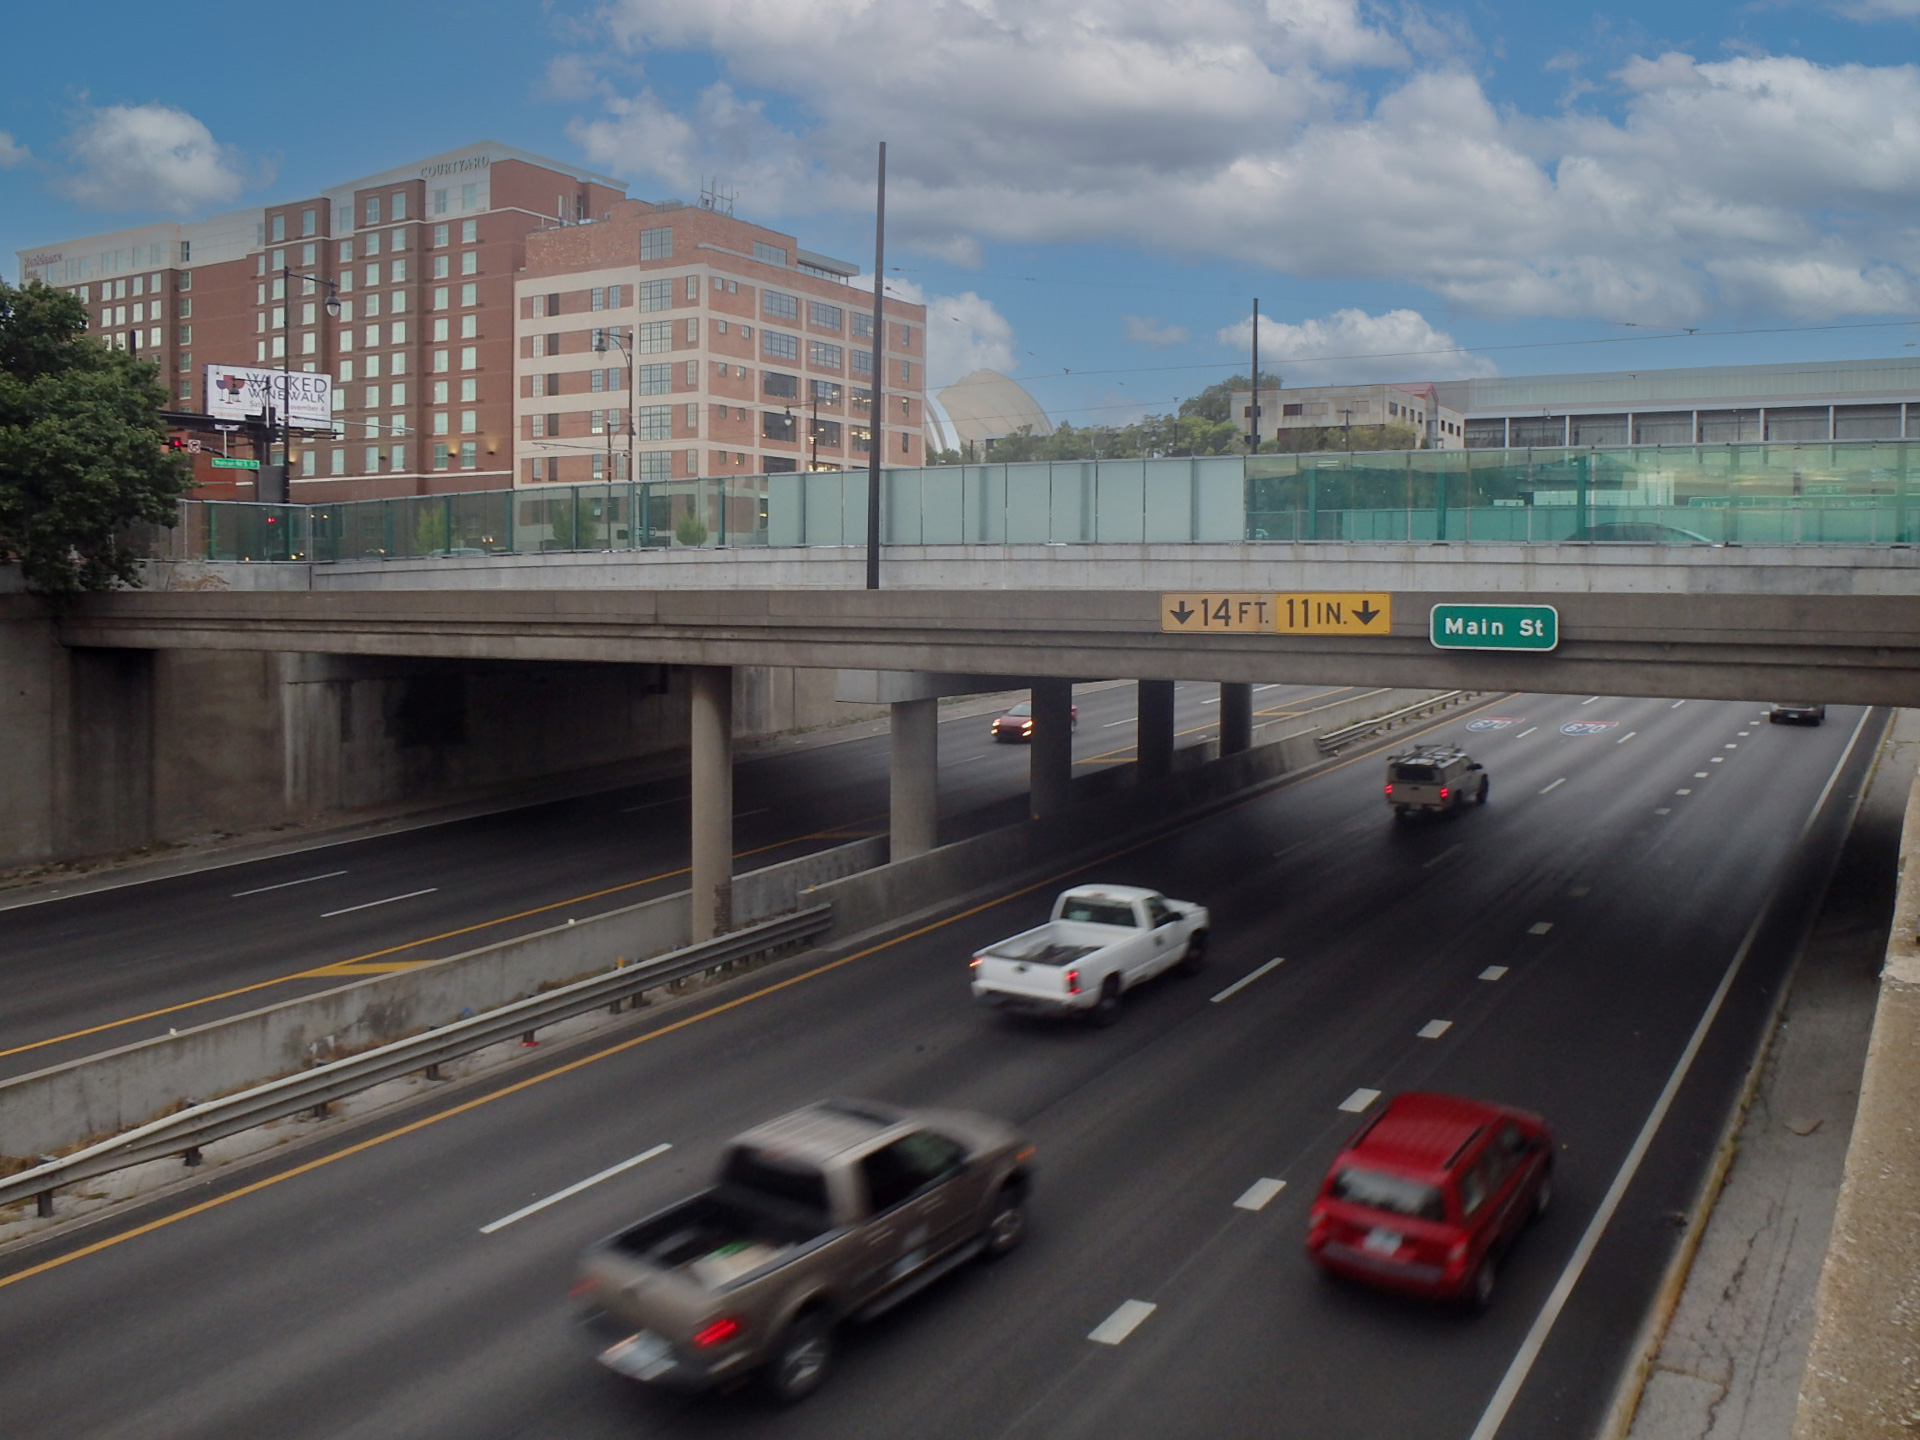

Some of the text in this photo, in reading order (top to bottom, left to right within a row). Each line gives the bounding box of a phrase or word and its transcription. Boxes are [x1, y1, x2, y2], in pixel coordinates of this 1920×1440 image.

[421, 155, 490, 179] COURTYARD
[246, 373, 327, 393] WICKED
[248, 388, 325, 403] WINE WALK
[287, 403, 318, 412] ovember
[1201, 597, 1348, 628] 14 FT. 11 IN.
[1445, 618, 1544, 637] Main St
[1470, 719, 1512, 730] 670
[1564, 724, 1604, 734] 670
